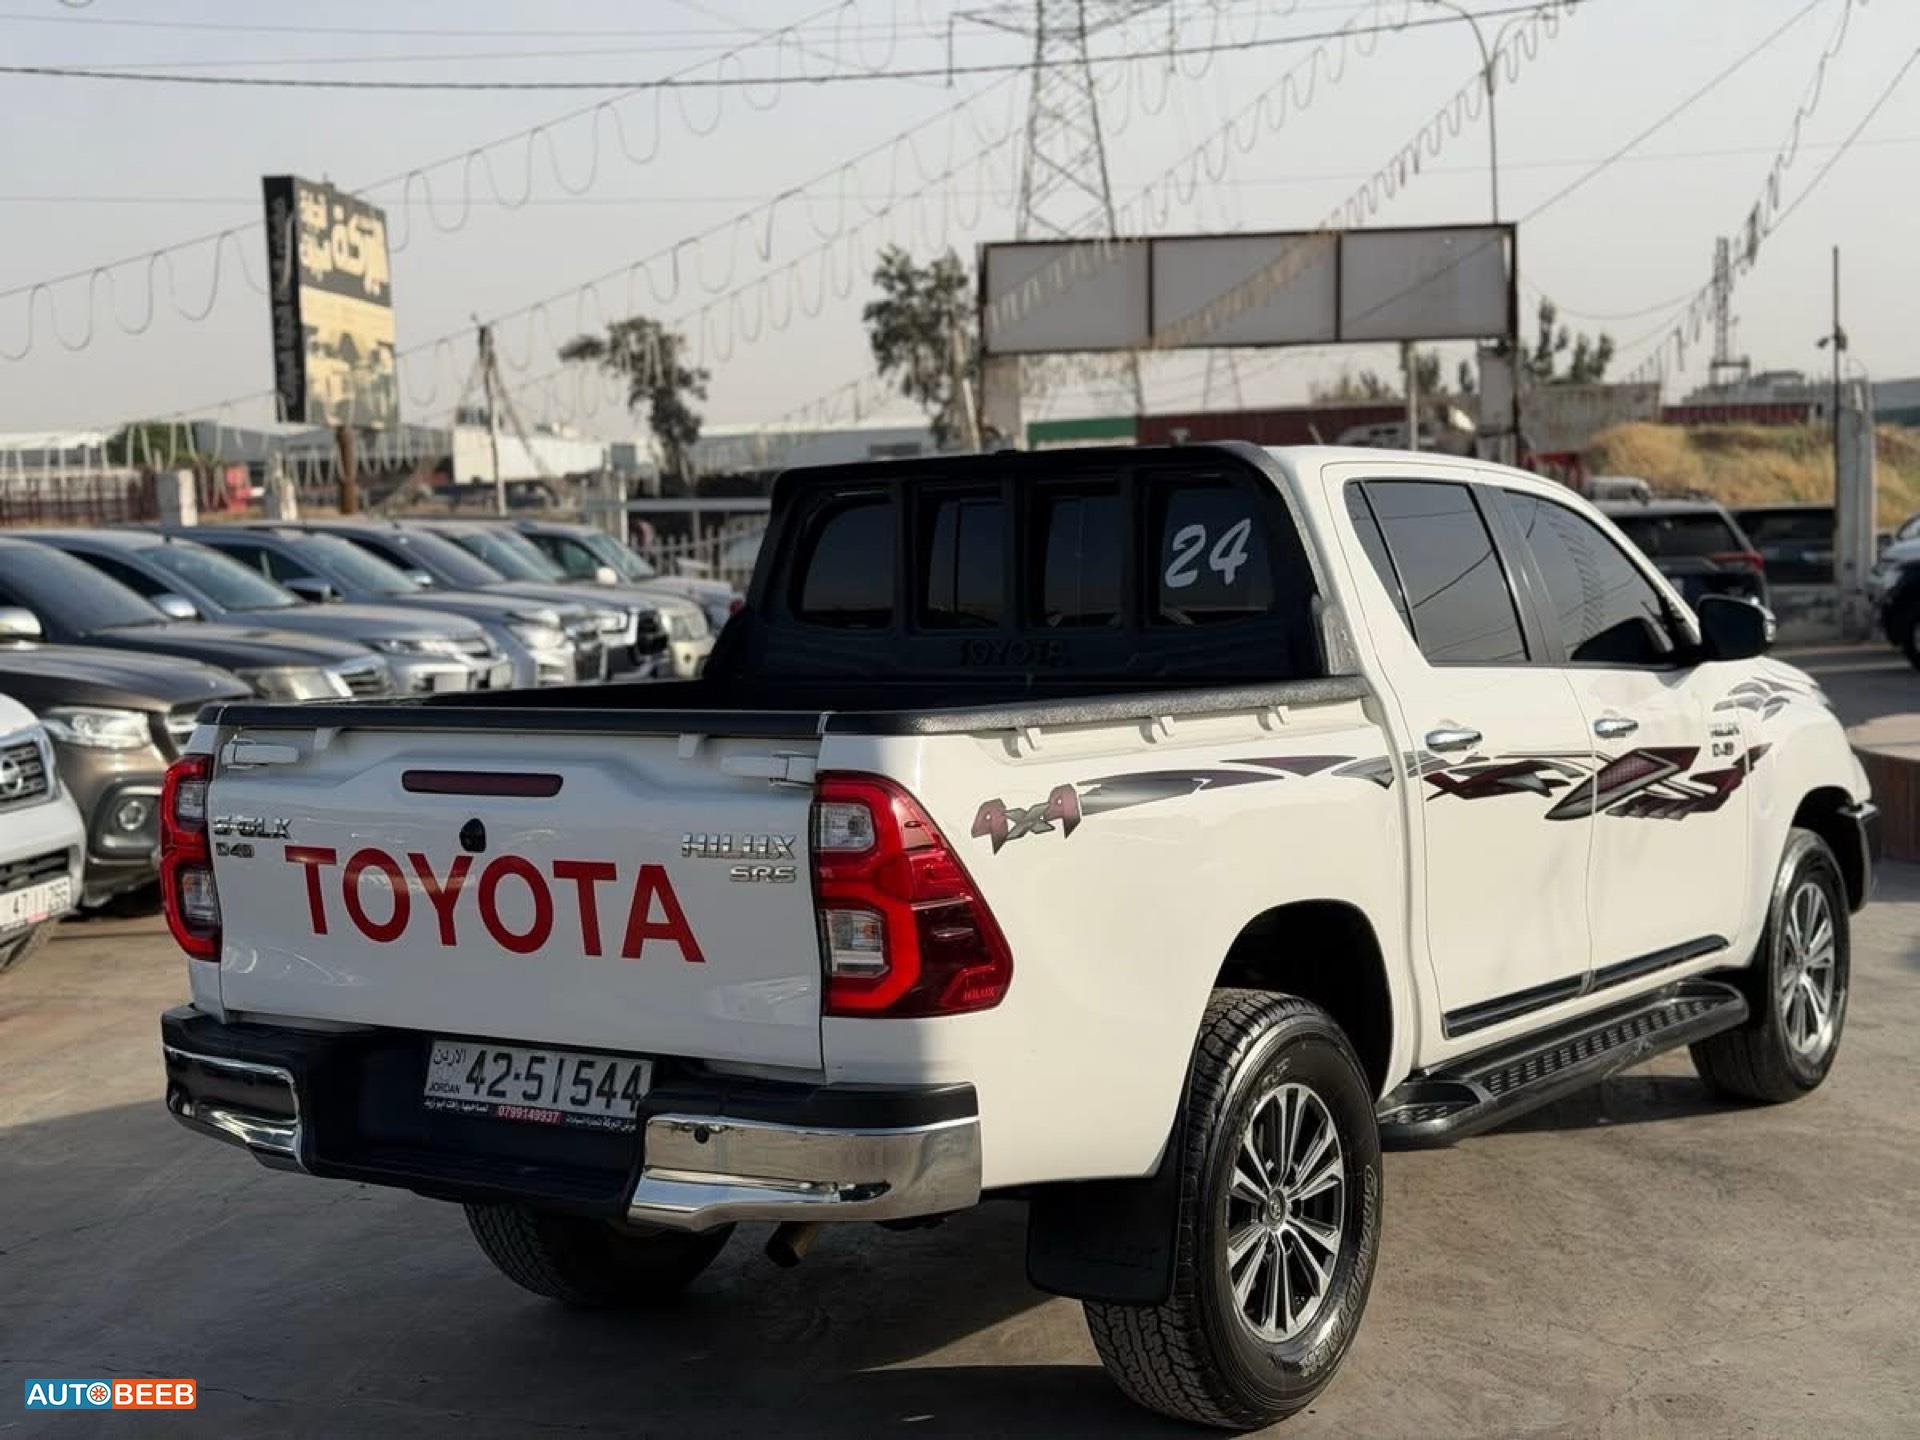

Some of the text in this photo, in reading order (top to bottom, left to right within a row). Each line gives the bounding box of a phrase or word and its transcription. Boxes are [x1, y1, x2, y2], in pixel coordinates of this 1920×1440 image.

[1165, 517, 1251, 588] 24
[681, 832, 796, 859] HILUX
[285, 845, 706, 963] TOYOTA
[428, 1082, 460, 1094] JORDAN
